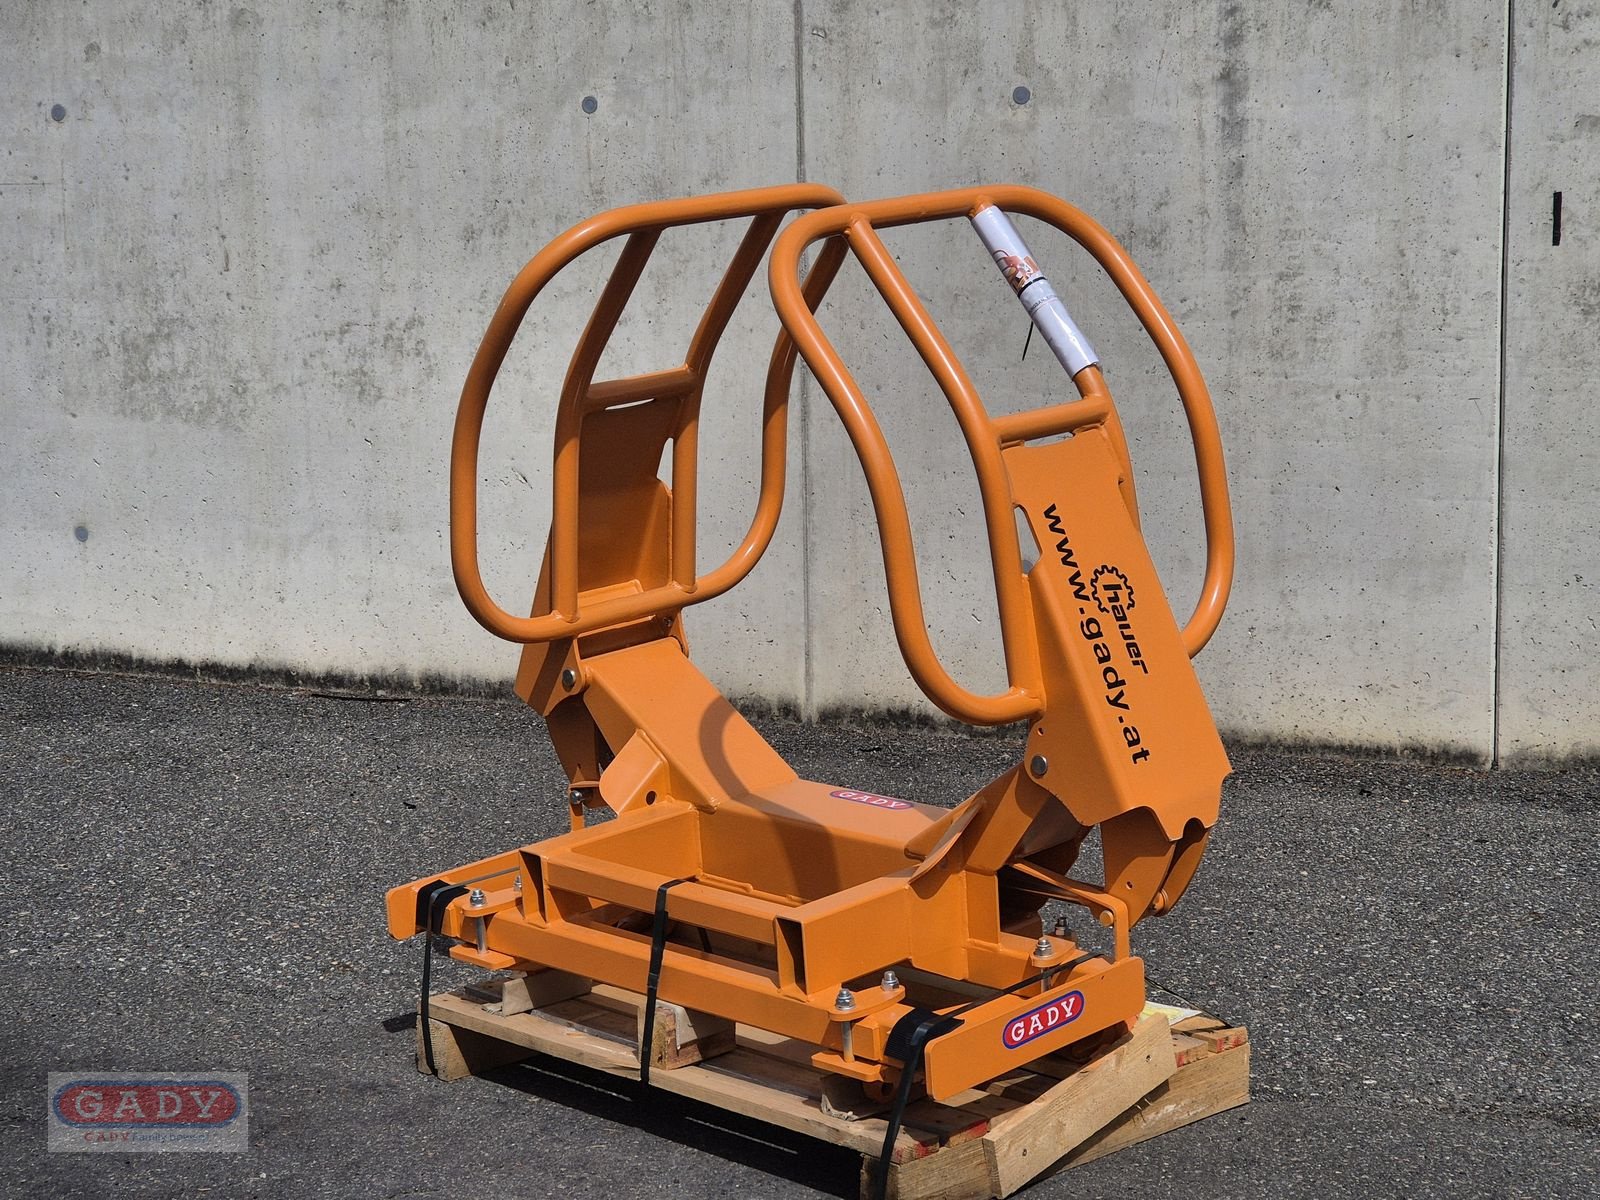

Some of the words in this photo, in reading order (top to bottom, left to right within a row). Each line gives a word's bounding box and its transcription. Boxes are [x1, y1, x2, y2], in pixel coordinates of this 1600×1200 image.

[1043, 503, 1151, 765] www.gady.at
[1102, 583, 1149, 675] hauer
[839, 791, 906, 808] GADY
[1011, 997, 1076, 1042] GADY
